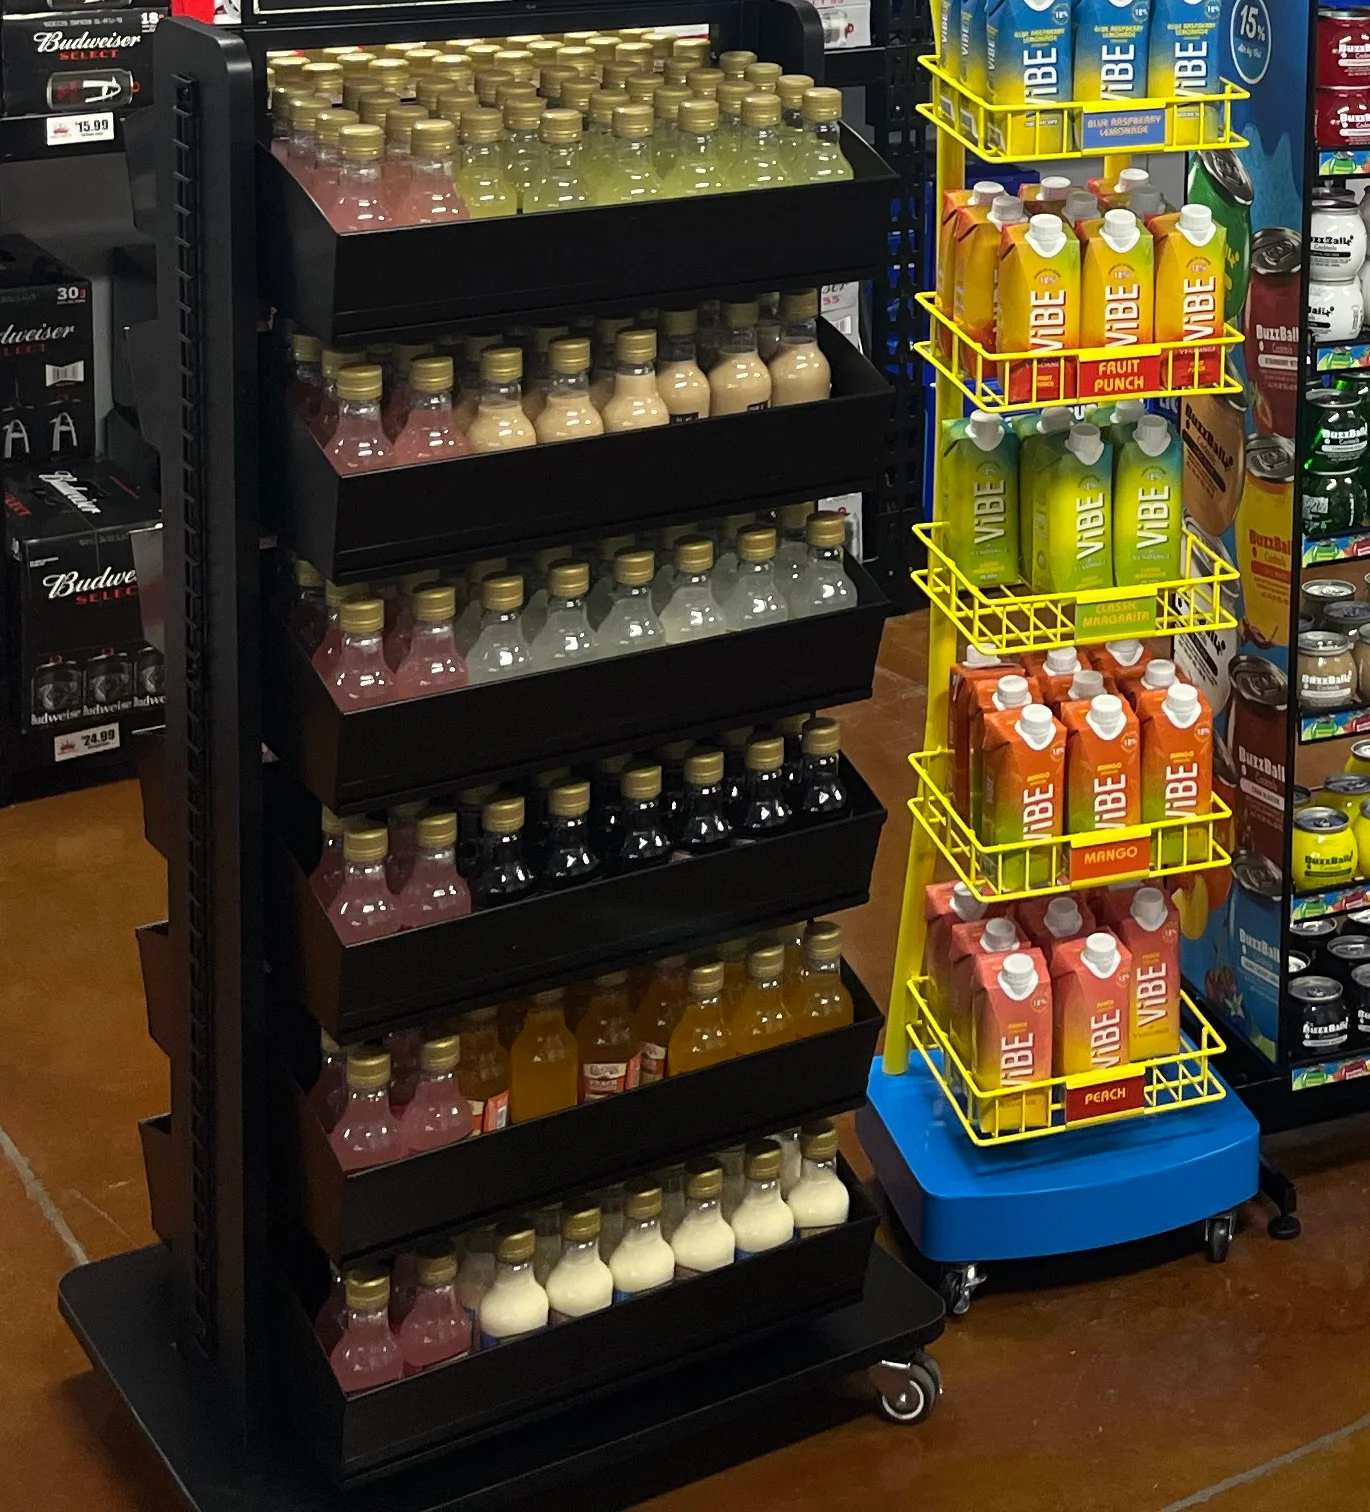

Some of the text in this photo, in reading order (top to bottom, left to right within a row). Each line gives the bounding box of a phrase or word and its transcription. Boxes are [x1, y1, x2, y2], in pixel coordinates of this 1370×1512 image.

[33, 30, 141, 52] Budweiser
[59, 50, 119, 60] SELECT
[57, 287, 78, 300] 30
[1099, 359, 1140, 375] FRUIT
[1094, 375, 1144, 392] PUNCH
[1084, 1087, 1126, 1105] PEACH
